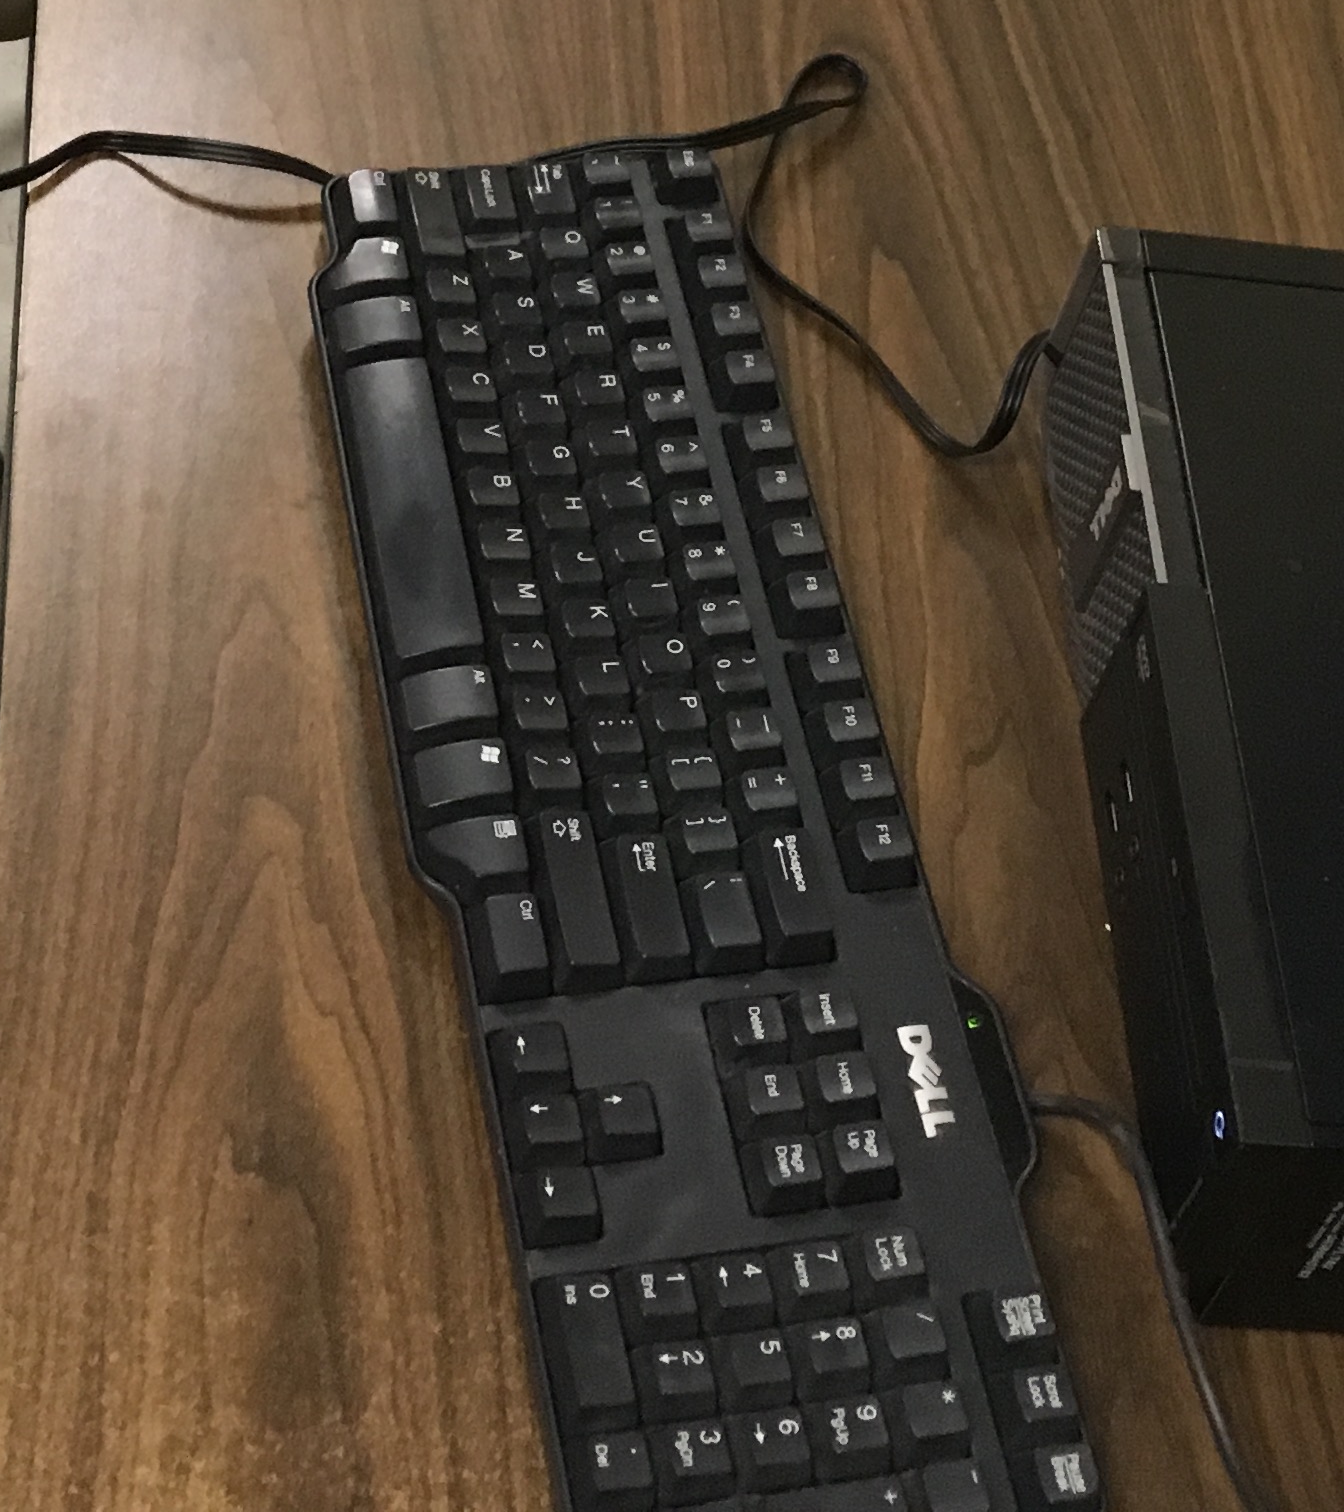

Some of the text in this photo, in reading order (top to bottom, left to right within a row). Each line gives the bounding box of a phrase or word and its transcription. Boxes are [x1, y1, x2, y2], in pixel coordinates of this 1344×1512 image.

[565, 231, 581, 243] Q
[508, 250, 523, 260] A
[715, 259, 726, 271] F2
[453, 275, 468, 285] Z
[577, 279, 594, 294] W
[517, 297, 534, 307] S
[622, 295, 635, 304] 3
[728, 305, 741, 319] F3
[462, 325, 479, 335] X
[587, 326, 604, 336] E
[529, 345, 546, 357] D
[743, 355, 754, 368] F4
[473, 373, 489, 384] C
[600, 375, 616, 387] R
[540, 394, 559, 406] F
[648, 393, 660, 401] 5
[484, 425, 501, 437] V
[614, 426, 630, 436] T
[761, 419, 772, 432] F5
[553, 446, 569, 458] G
[661, 444, 674, 452] 6
[494, 475, 511, 487] B
[627, 477, 643, 489] Y
[775, 471, 787, 483] F6
[565, 497, 582, 509] H
[675, 497, 688, 505] 7
[507, 529, 523, 541] N
[639, 529, 656, 542] U
[791, 523, 804, 537] F7
[577, 552, 594, 561] J
[689, 549, 702, 558] 8
[806, 577, 818, 590] F8
[518, 584, 536, 598] M
[590, 606, 608, 618] K
[703, 603, 716, 611] 9
[667, 640, 683, 653] O
[827, 649, 839, 663] F9
[602, 662, 619, 672] L
[680, 697, 697, 708] P
[843, 706, 857, 726] F10
[859, 764, 873, 781] F11
[876, 825, 891, 844] F12
[642, 842, 656, 871] Enter
[520, 900, 534, 920] Ctrl
[819, 994, 836, 1025] Insert
[765, 1075, 780, 1097] End
[897, 1025, 955, 1138] DELL
[818, 1249, 838, 1262] 7
[744, 1264, 762, 1277] 4
[590, 1285, 610, 1298] 0
[836, 1327, 856, 1339] 8
[760, 1341, 781, 1354] 5
[683, 1351, 704, 1365] 2
[857, 1405, 877, 1420] 9
[779, 1419, 799, 1434] 6
[700, 1431, 721, 1444] 3
